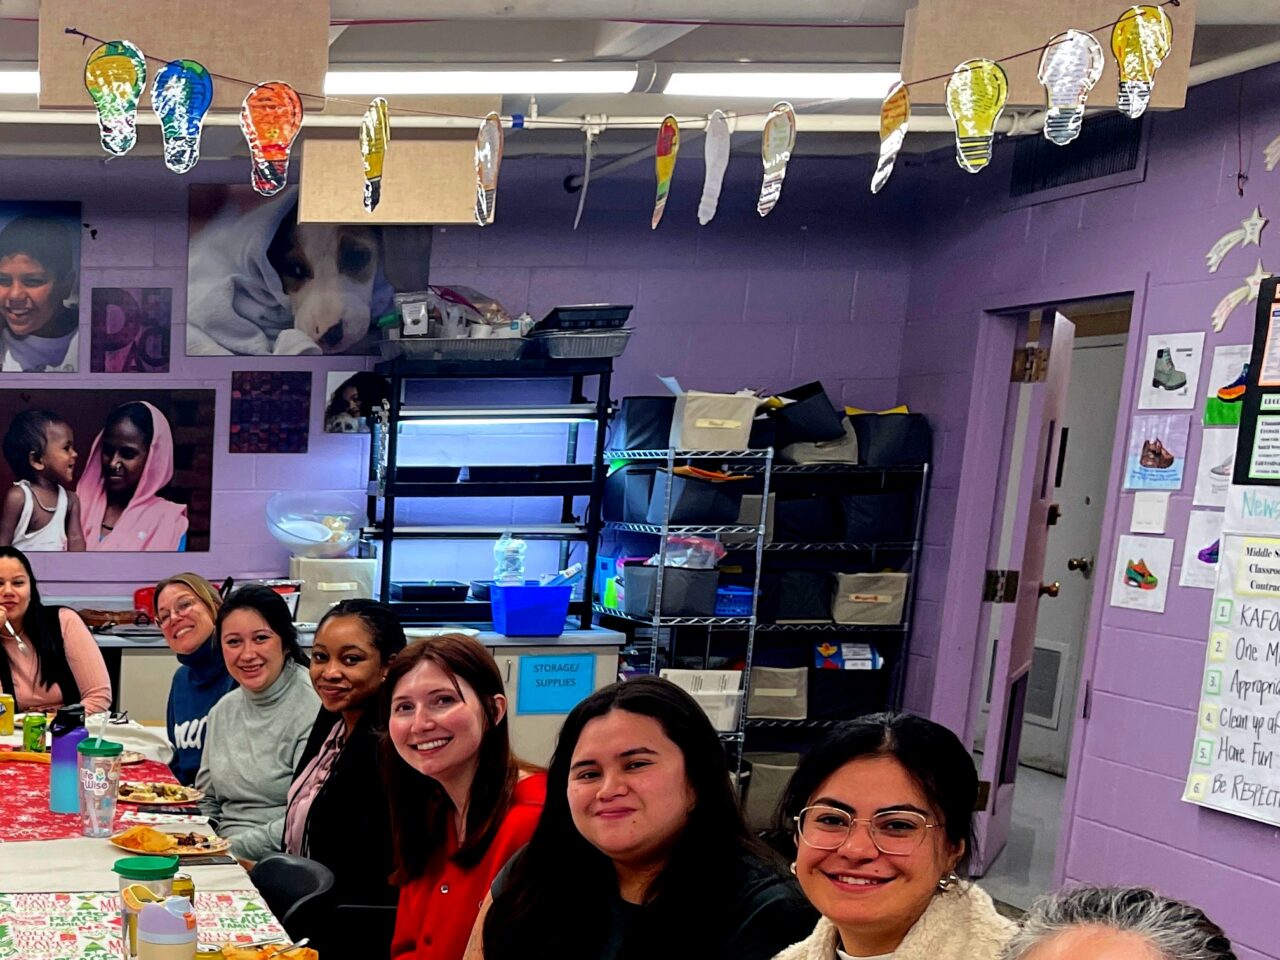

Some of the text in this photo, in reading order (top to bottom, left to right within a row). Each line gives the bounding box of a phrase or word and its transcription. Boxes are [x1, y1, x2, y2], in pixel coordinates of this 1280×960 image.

[1246, 547, 1272, 558] Middle
[1235, 637, 1258, 661] One
[534, 663, 580, 673] STORAGE/
[536, 678, 576, 688] SUPPLIES
[1220, 707, 1248, 730] Clean
[1252, 715, 1265, 740] up
[1218, 736, 1246, 763] Have
[1251, 742, 1273, 769] Fun
[1211, 774, 1227, 794] Be
